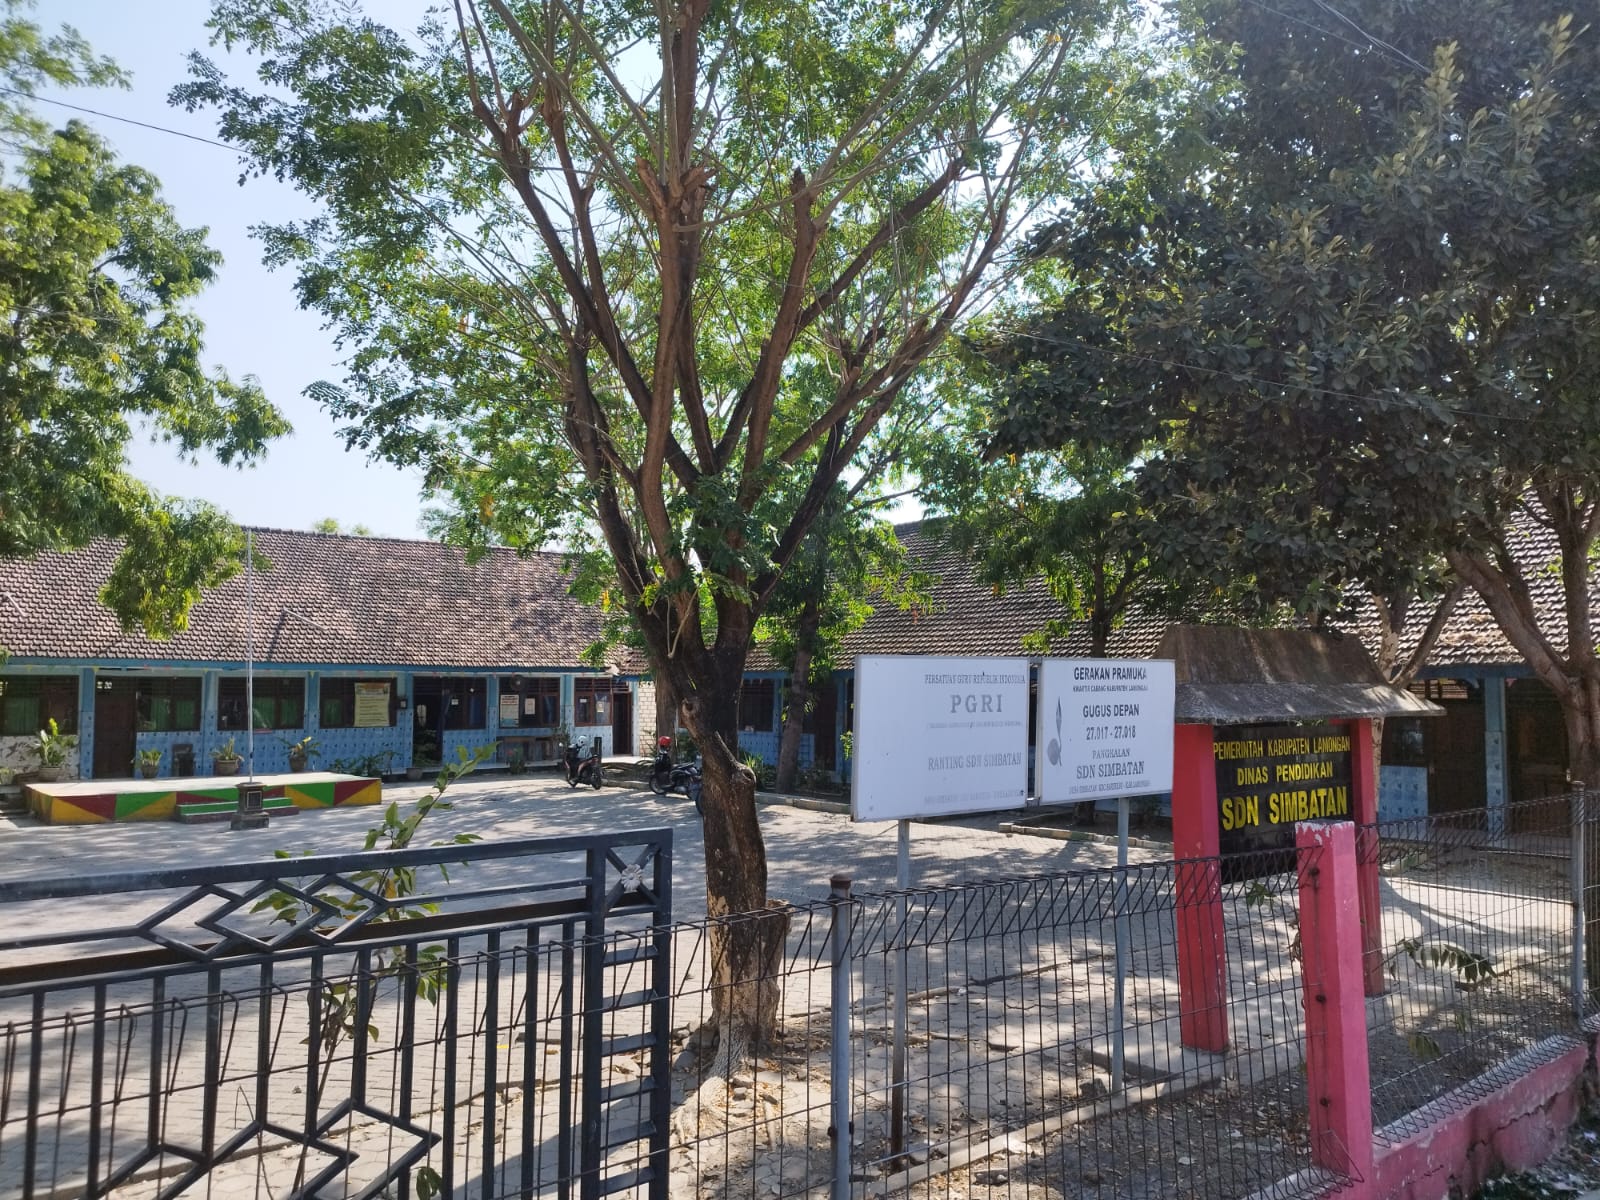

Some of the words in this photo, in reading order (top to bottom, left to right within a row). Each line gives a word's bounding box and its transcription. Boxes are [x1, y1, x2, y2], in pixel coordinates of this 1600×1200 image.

[1074, 667, 1110, 680] GERAKAN
[1112, 667, 1147, 680] PRAMUKA
[951, 694, 1003, 713] PGRI
[1083, 705, 1112, 718] GUGUS
[1114, 704, 1140, 717] DEPAN
[1086, 726, 1108, 740] 27.017
[1114, 726, 1136, 738] 27.018
[1092, 748, 1130, 759] PANGKALAN
[1214, 740, 1264, 760] PEMERINTAH
[1268, 738, 1310, 757] KABUPATEN
[1313, 736, 1351, 754] LAMONGAN
[928, 756, 964, 770] RANTING
[966, 754, 982, 768] SDN
[984, 752, 1022, 768] SIMBATAN
[1076, 764, 1096, 780] SDN
[1098, 761, 1145, 778] SIMBATAN
[1237, 766, 1269, 786] DINAS
[1276, 761, 1334, 783] PENDIDIKAN
[1222, 795, 1259, 831] SDN
[1269, 786, 1348, 824] SIMBATAN
